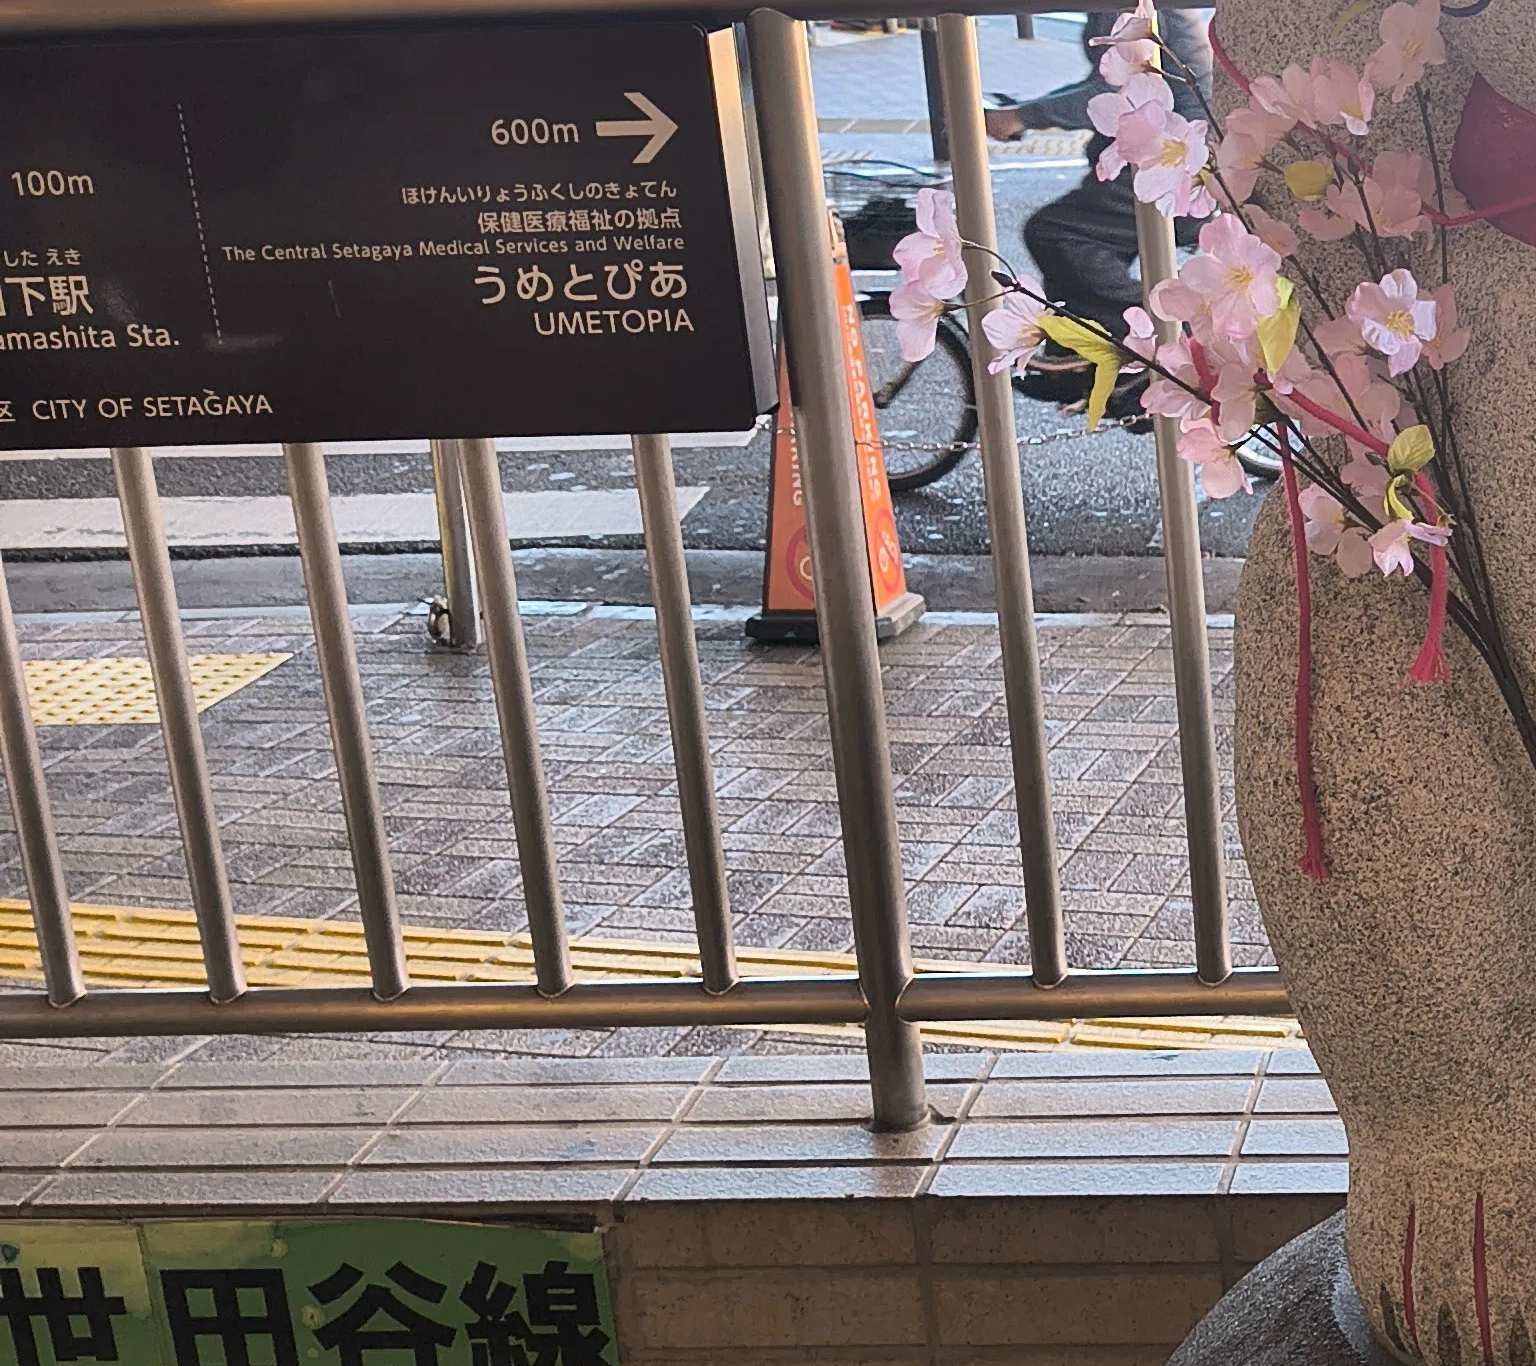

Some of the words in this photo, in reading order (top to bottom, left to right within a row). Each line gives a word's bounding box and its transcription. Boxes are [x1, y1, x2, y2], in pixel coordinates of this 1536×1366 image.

[491, 119, 579, 145] 600m
[11, 171, 94, 196] 100m
[401, 181, 677, 204] ほけんいりょうふくしのきょてん
[477, 208, 682, 234] 保健医療福祉の拠点
[222, 246, 256, 261] The
[261, 244, 327, 260] Central
[332, 242, 413, 261] Setagaya
[419, 240, 490, 256] Medical
[496, 238, 568, 253] Services
[575, 237, 607, 251] and
[615, 235, 685, 250] Welfare
[474, 258, 688, 305] うめとぴあ
[0, 275, 93, 317] 下駅
[534, 308, 695, 335] UMETOPIA
[126, 324, 180, 347] Sta.
[32, 399, 87, 420] CITY
[98, 397, 133, 418] OF
[143, 394, 273, 417] SETAGAYA
